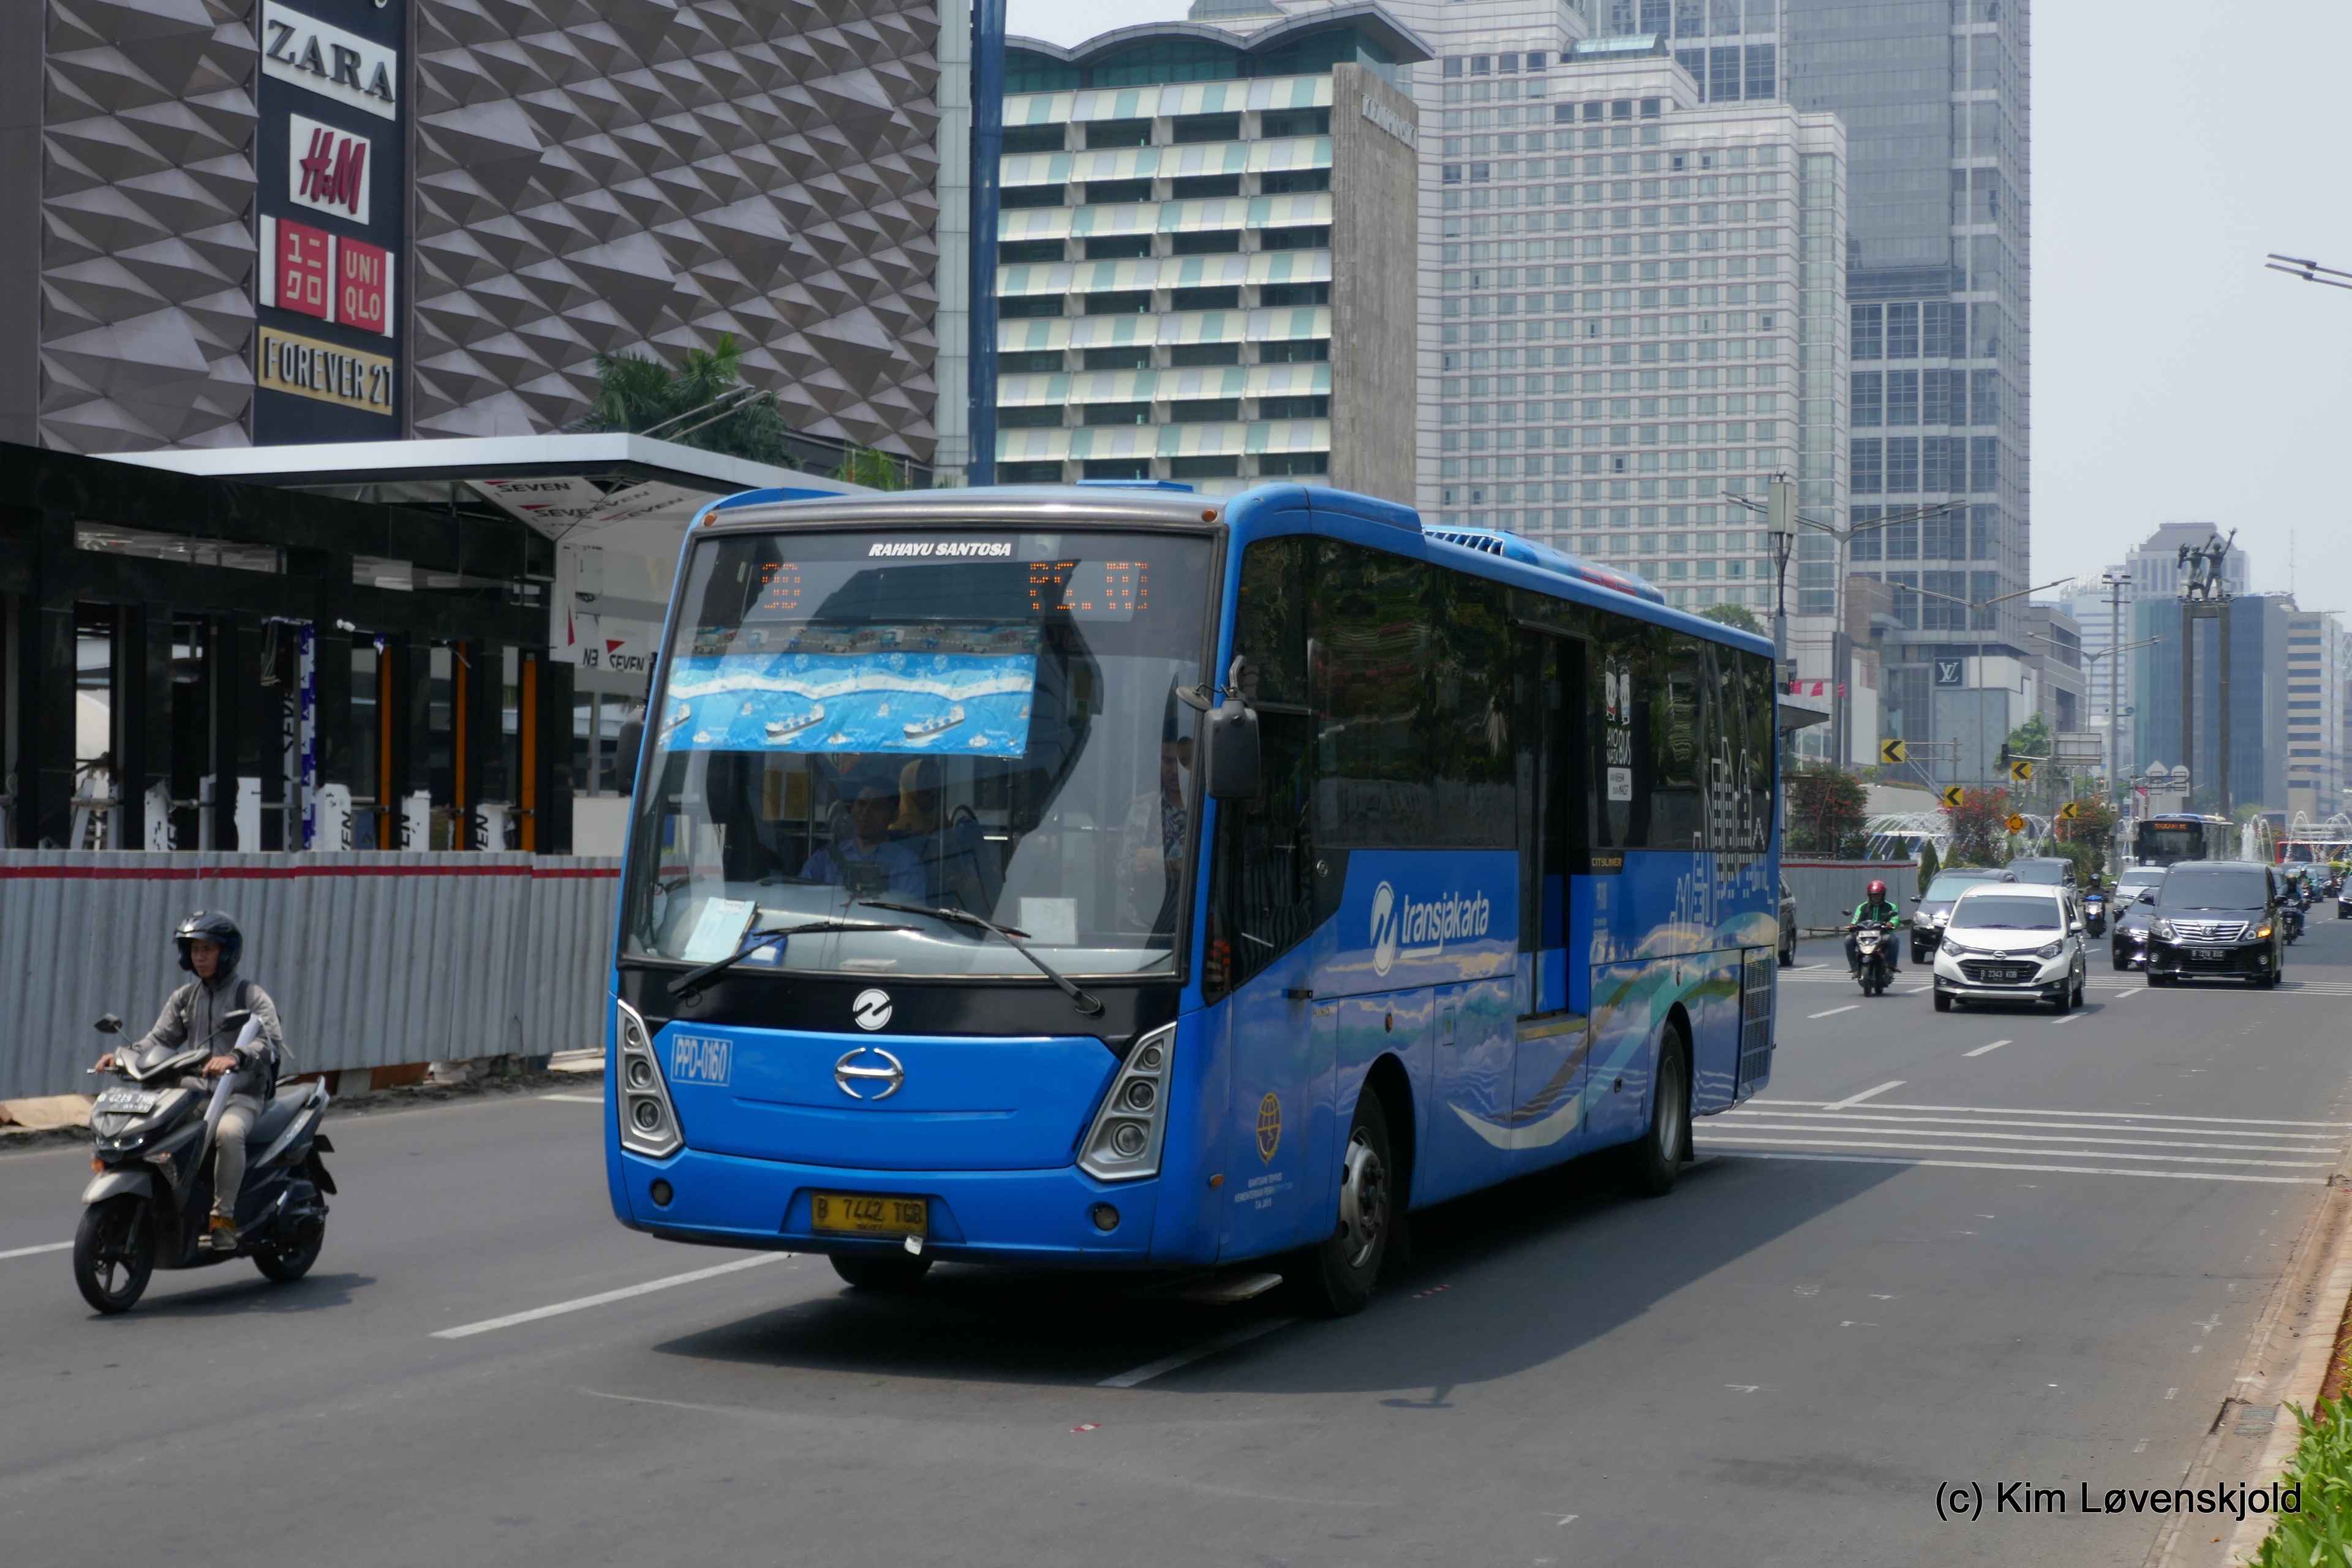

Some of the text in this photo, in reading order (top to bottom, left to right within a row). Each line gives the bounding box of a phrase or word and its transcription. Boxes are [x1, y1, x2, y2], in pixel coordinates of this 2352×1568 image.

[268, 19, 397, 103] ZARA
[299, 127, 366, 215] H&M
[345, 250, 378, 287] UNI
[345, 290, 380, 321] QLO
[263, 337, 393, 406] FOREVER 21
[496, 482, 571, 492] SEVEN
[868, 543, 1012, 557] RAHAYU SANTOSA
[1606, 727, 1618, 747] AYO
[1618, 729, 1631, 766] BUS
[1592, 858, 1623, 867] CITYLINER
[1400, 889, 1490, 959] transjakarta
[1313, 1008, 1330, 1018] HINO
[674, 1038, 728, 1082] PPD-0160
[818, 1196, 827, 1219] B
[843, 1197, 884, 1221] 7442
